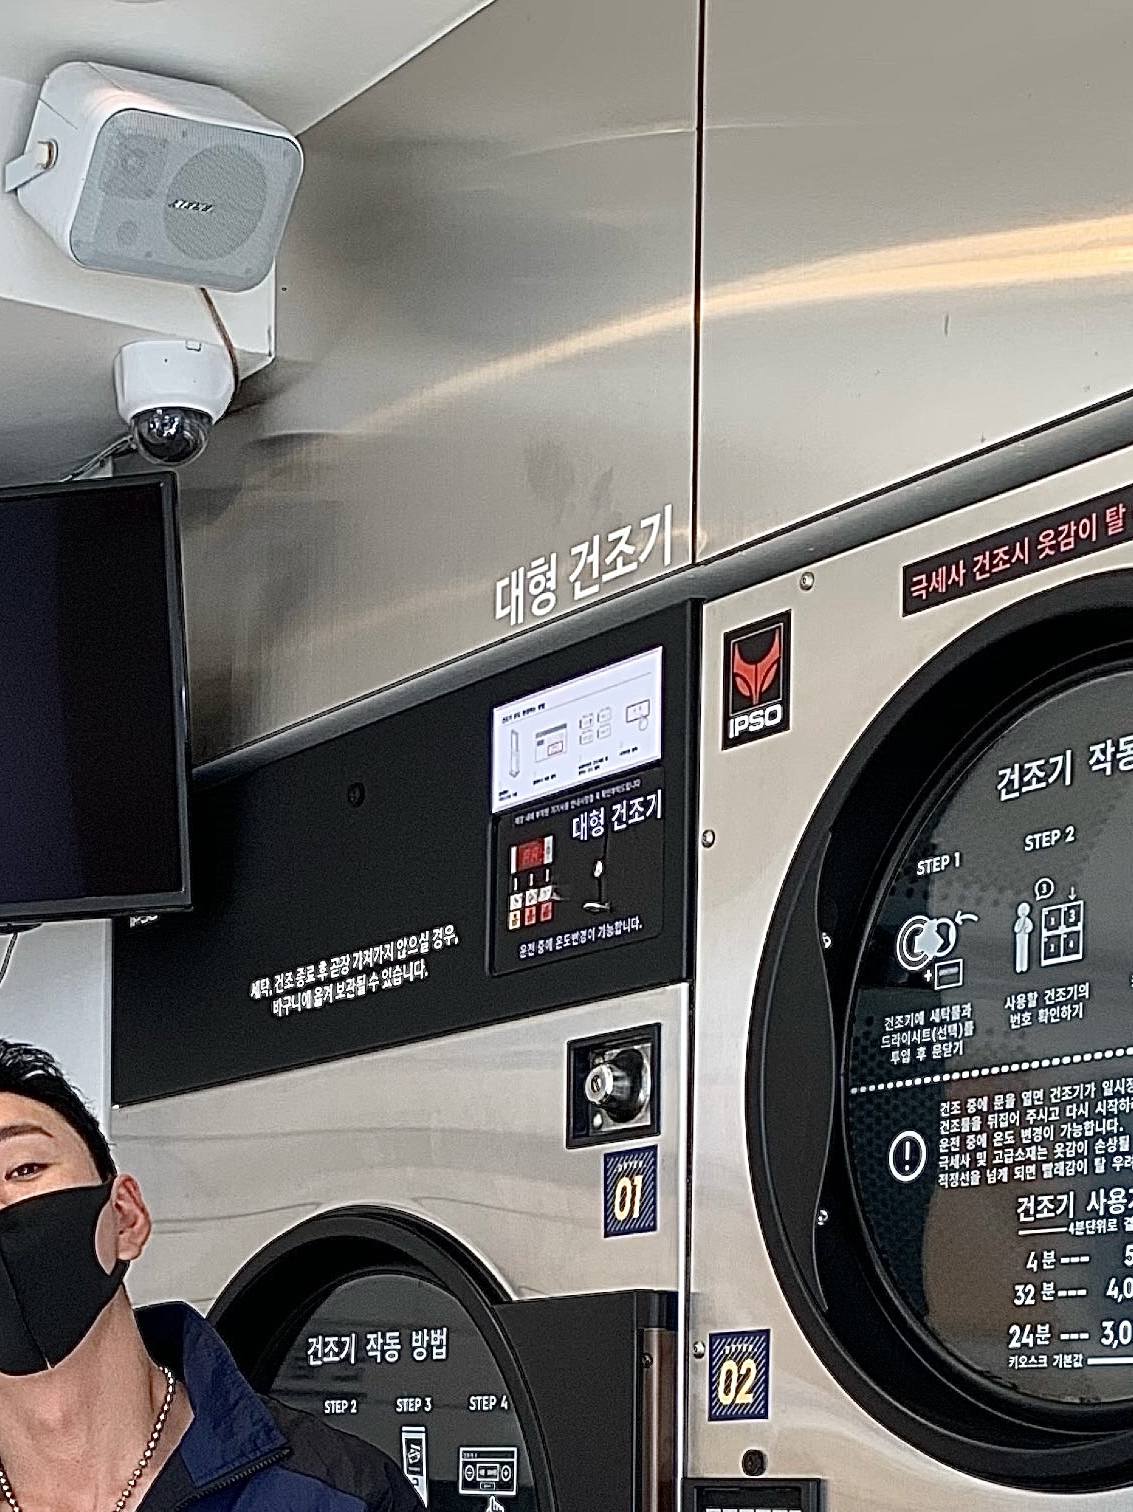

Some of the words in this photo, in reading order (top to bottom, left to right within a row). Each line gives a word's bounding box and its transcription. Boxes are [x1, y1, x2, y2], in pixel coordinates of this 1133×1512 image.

[495, 552, 557, 626] 대형
[568, 503, 673, 601] 건조기
[910, 558, 967, 601] 극세사
[972, 537, 1031, 582] 건조시
[1037, 513, 1099, 559] 옷감이
[1105, 502, 1126, 536] 탈
[728, 703, 782, 740] IPSO
[996, 748, 1073, 802] 건조기
[572, 807, 605, 841] 대형
[611, 789, 662, 832] 건조기
[1024, 828, 1062, 852] STEP
[1065, 825, 1076, 843] 2
[917, 854, 950, 876] STEP
[250, 978, 273, 999] 세탁,
[274, 972, 294, 994] 건조
[295, 965, 316, 988] 종료
[317, 960, 329, 982] 후
[352, 942, 394, 971] 가져가지
[397, 931, 429, 960] 않으실
[432, 924, 459, 950] 경우,
[272, 989, 313, 1017] 바구니에
[367, 972, 380, 993] 수
[381, 958, 429, 990] 있습니다.
[1004, 991, 1038, 1012] 사용할
[1044, 981, 1090, 1003] 건조기의
[883, 1009, 926, 1032] 건조기에
[929, 1002, 972, 1023] 세탁물과
[1009, 1011, 1032, 1030] 번호
[1037, 1003, 1084, 1025] 확인하기
[890, 1048, 911, 1066] 투입
[940, 1100, 961, 1117] 건조
[966, 1096, 989, 1114] 중에
[993, 1093, 1016, 1111] 문을
[1021, 1088, 1044, 1107] 열면
[1049, 1081, 1096, 1103] 건조기가
[987, 1110, 1020, 1129] 뒤집어
[1025, 1106, 1060, 1125] 주시고
[1066, 1101, 1089, 1119] 다시
[939, 1135, 960, 1153] 운전
[966, 1132, 987, 1150] 중에
[992, 1130, 1015, 1147] 온도
[1020, 1124, 1054, 1143] 변경이
[1060, 1117, 1124, 1139] 가능합니다.
[938, 1152, 971, 1171] 극세사
[976, 1150, 987, 1167] 및
[992, 1144, 1048, 1164] 고급소재는
[1053, 1139, 1087, 1159] 옷감이
[987, 1166, 1009, 1184] 넘게
[1013, 1163, 1036, 1181] 되면
[613, 1174, 643, 1222] 01
[1017, 1190, 1074, 1223] 건조기
[1068, 1218, 1118, 1236] 4분단위로
[307, 1332, 356, 1366] 건조기
[365, 1331, 401, 1363] 작동
[411, 1327, 448, 1361] 방법
[1008, 1354, 1048, 1369] 키오스크
[717, 1358, 757, 1405] 02
[324, 1400, 349, 1414] STEP
[395, 1398, 422, 1413] STEP
[469, 1395, 496, 1411] STEP
[500, 1395, 509, 1410] 4
